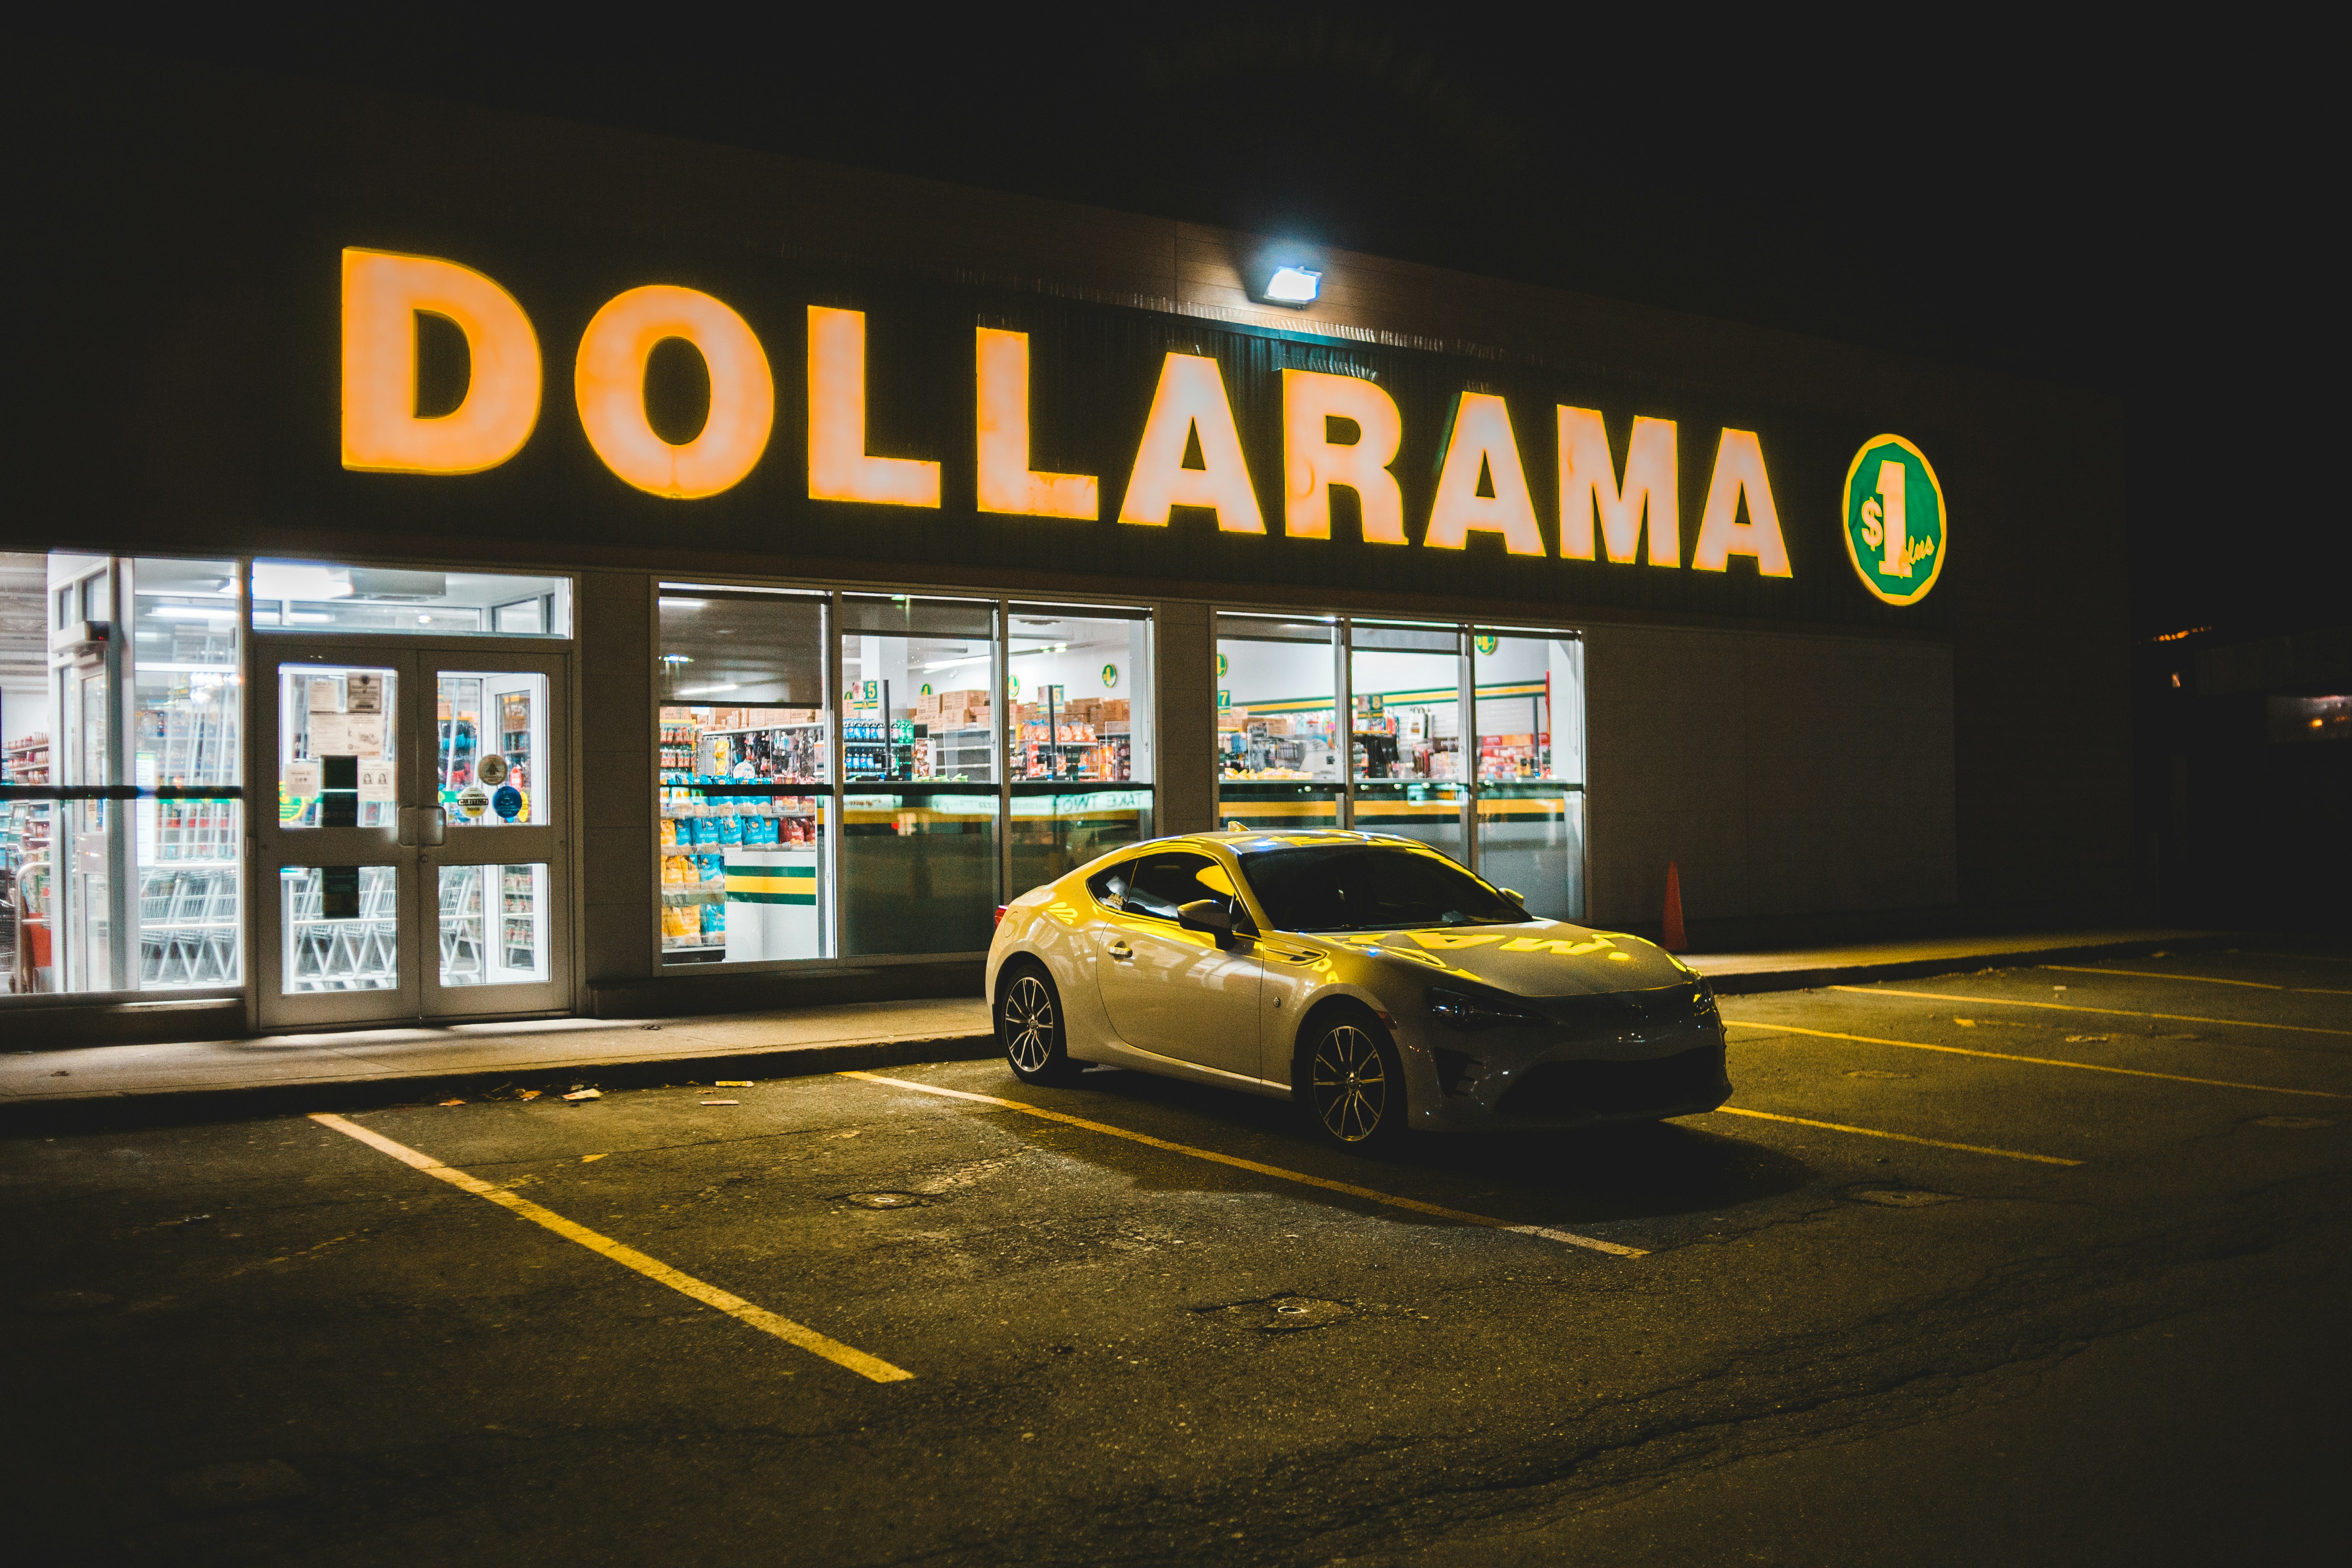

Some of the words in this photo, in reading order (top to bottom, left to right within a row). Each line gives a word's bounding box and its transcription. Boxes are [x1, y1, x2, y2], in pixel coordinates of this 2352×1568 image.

[341, 248, 1794, 579] DOLLARAMA
[1862, 460, 1912, 578] $1
[1899, 535, 1935, 579] plus
[868, 682, 876, 698] 5
[1054, 688, 1061, 702] 6
[1220, 692, 1228, 705] 7
[1372, 695, 1381, 709] 8
